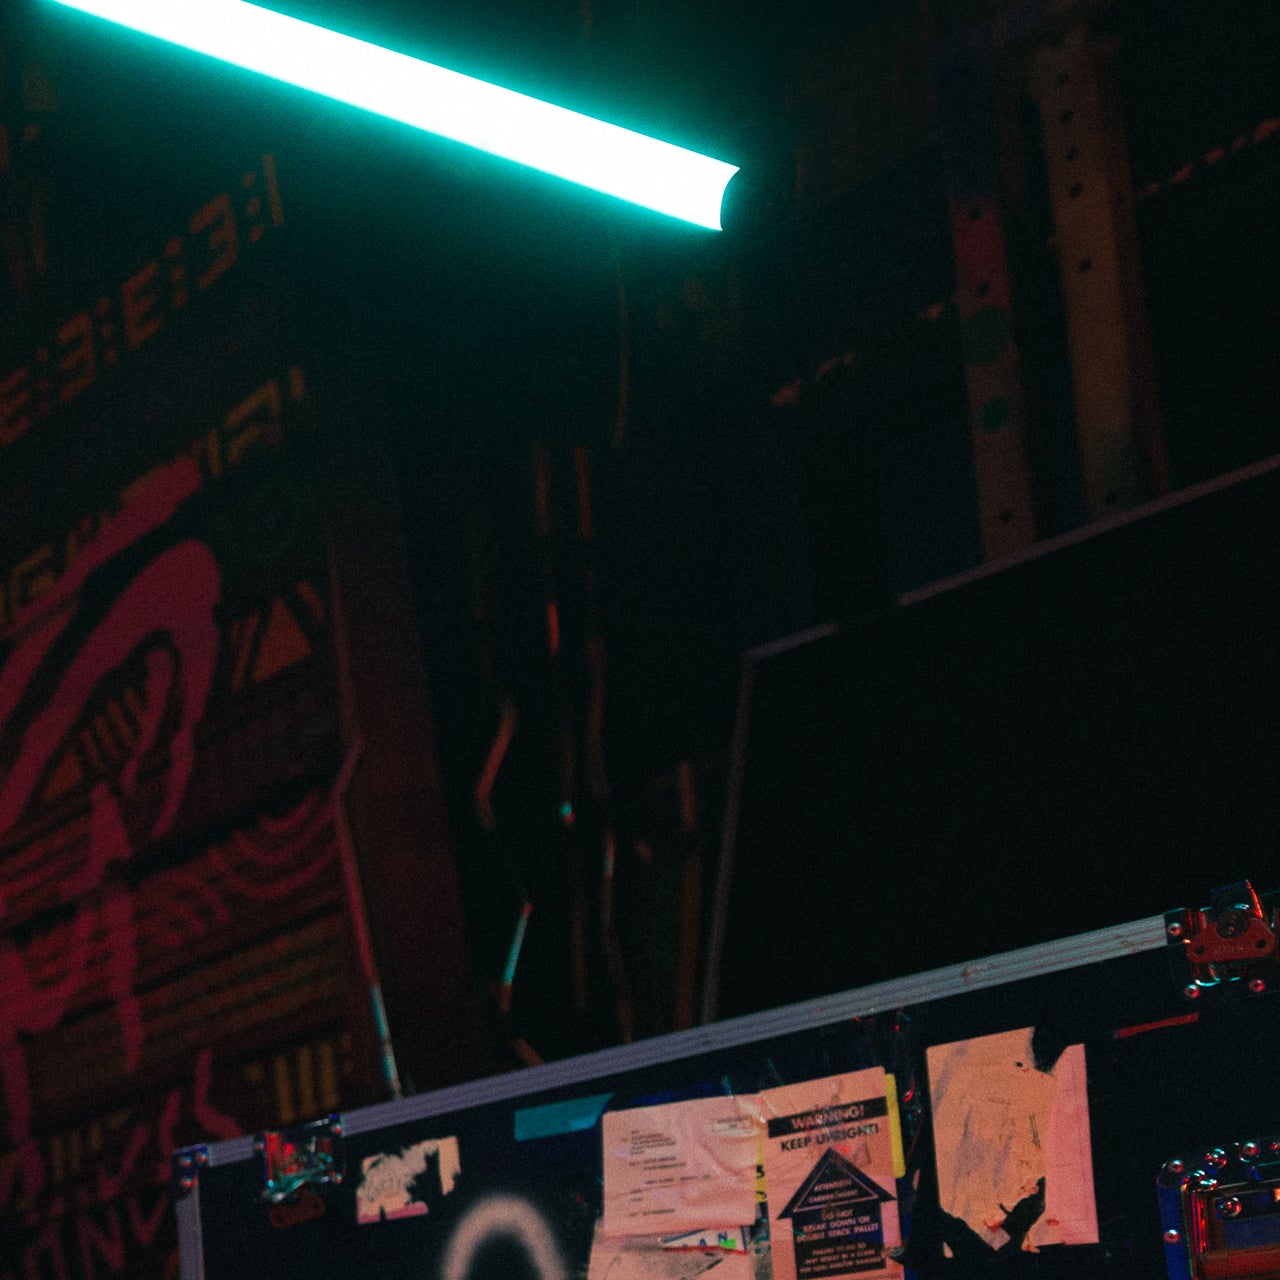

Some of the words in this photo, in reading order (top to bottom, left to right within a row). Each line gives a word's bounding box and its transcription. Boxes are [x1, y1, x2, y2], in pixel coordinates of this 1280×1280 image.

[791, 1103, 865, 1129] WARNING!
[780, 1136, 812, 1152] KEEP
[815, 1122, 880, 1146] UPRIGHT!
